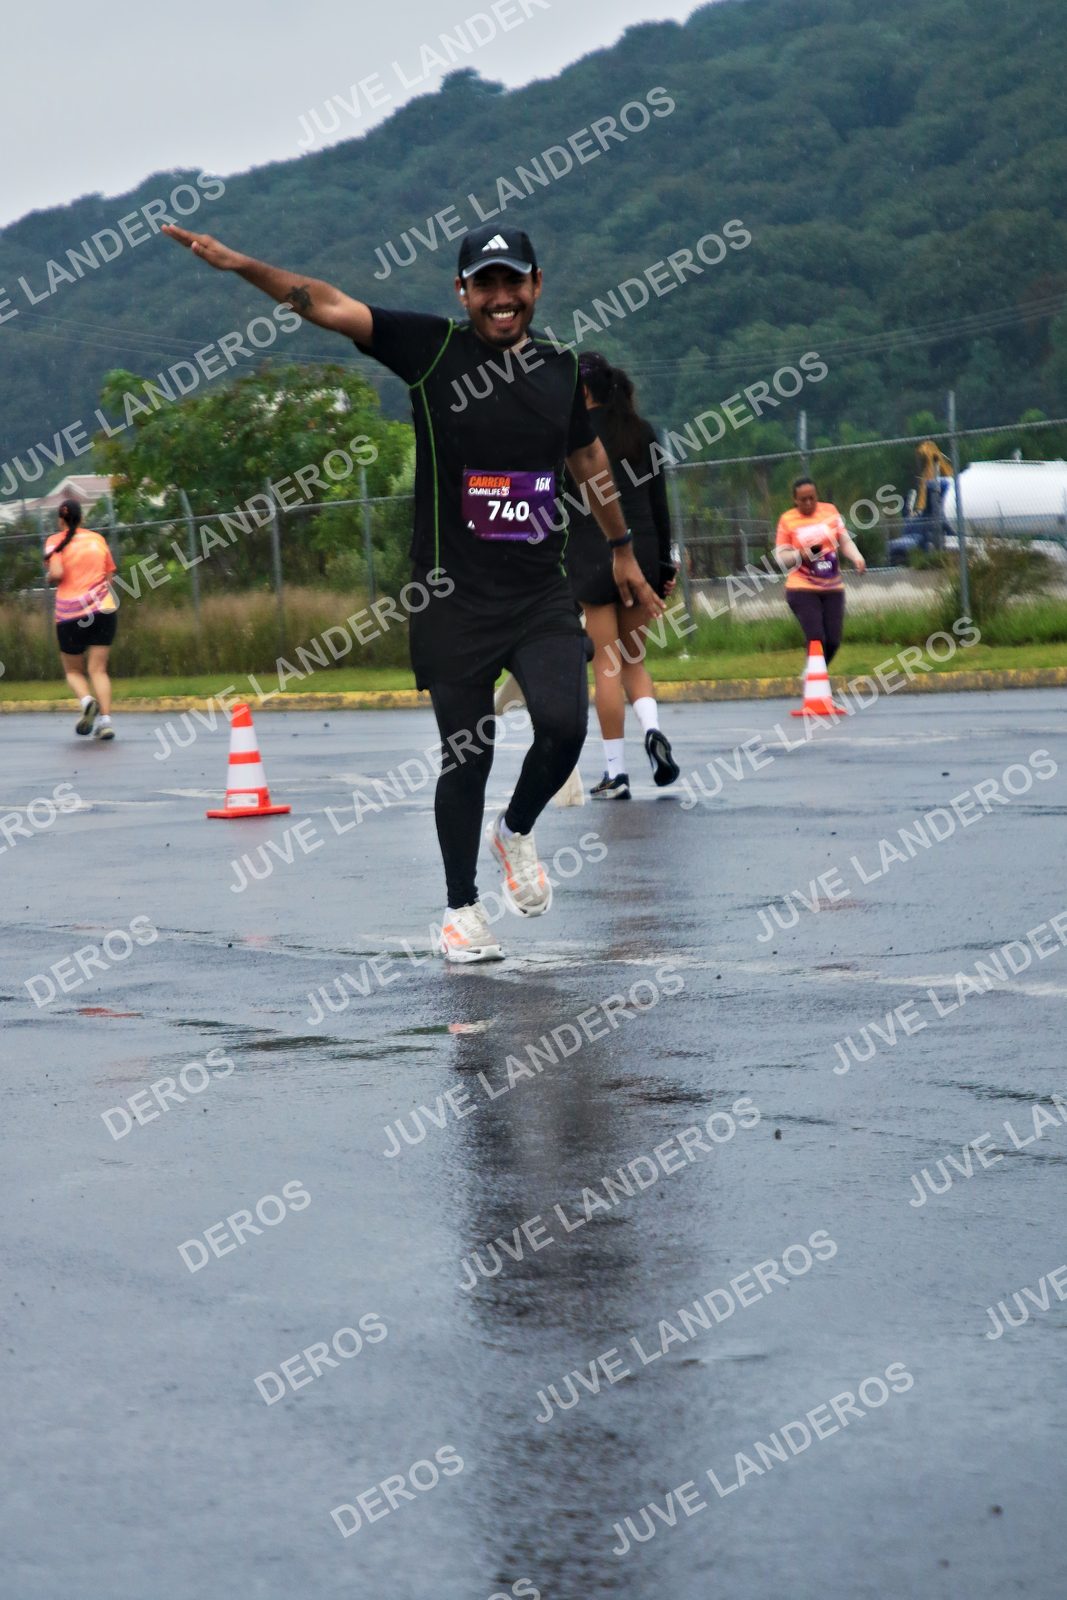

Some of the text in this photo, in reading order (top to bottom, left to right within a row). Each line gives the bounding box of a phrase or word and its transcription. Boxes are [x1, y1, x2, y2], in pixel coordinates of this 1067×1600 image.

[469, 476, 511, 487] CARRERA
[469, 488, 500, 496] OMNILIFE
[487, 500, 530, 521] 740
